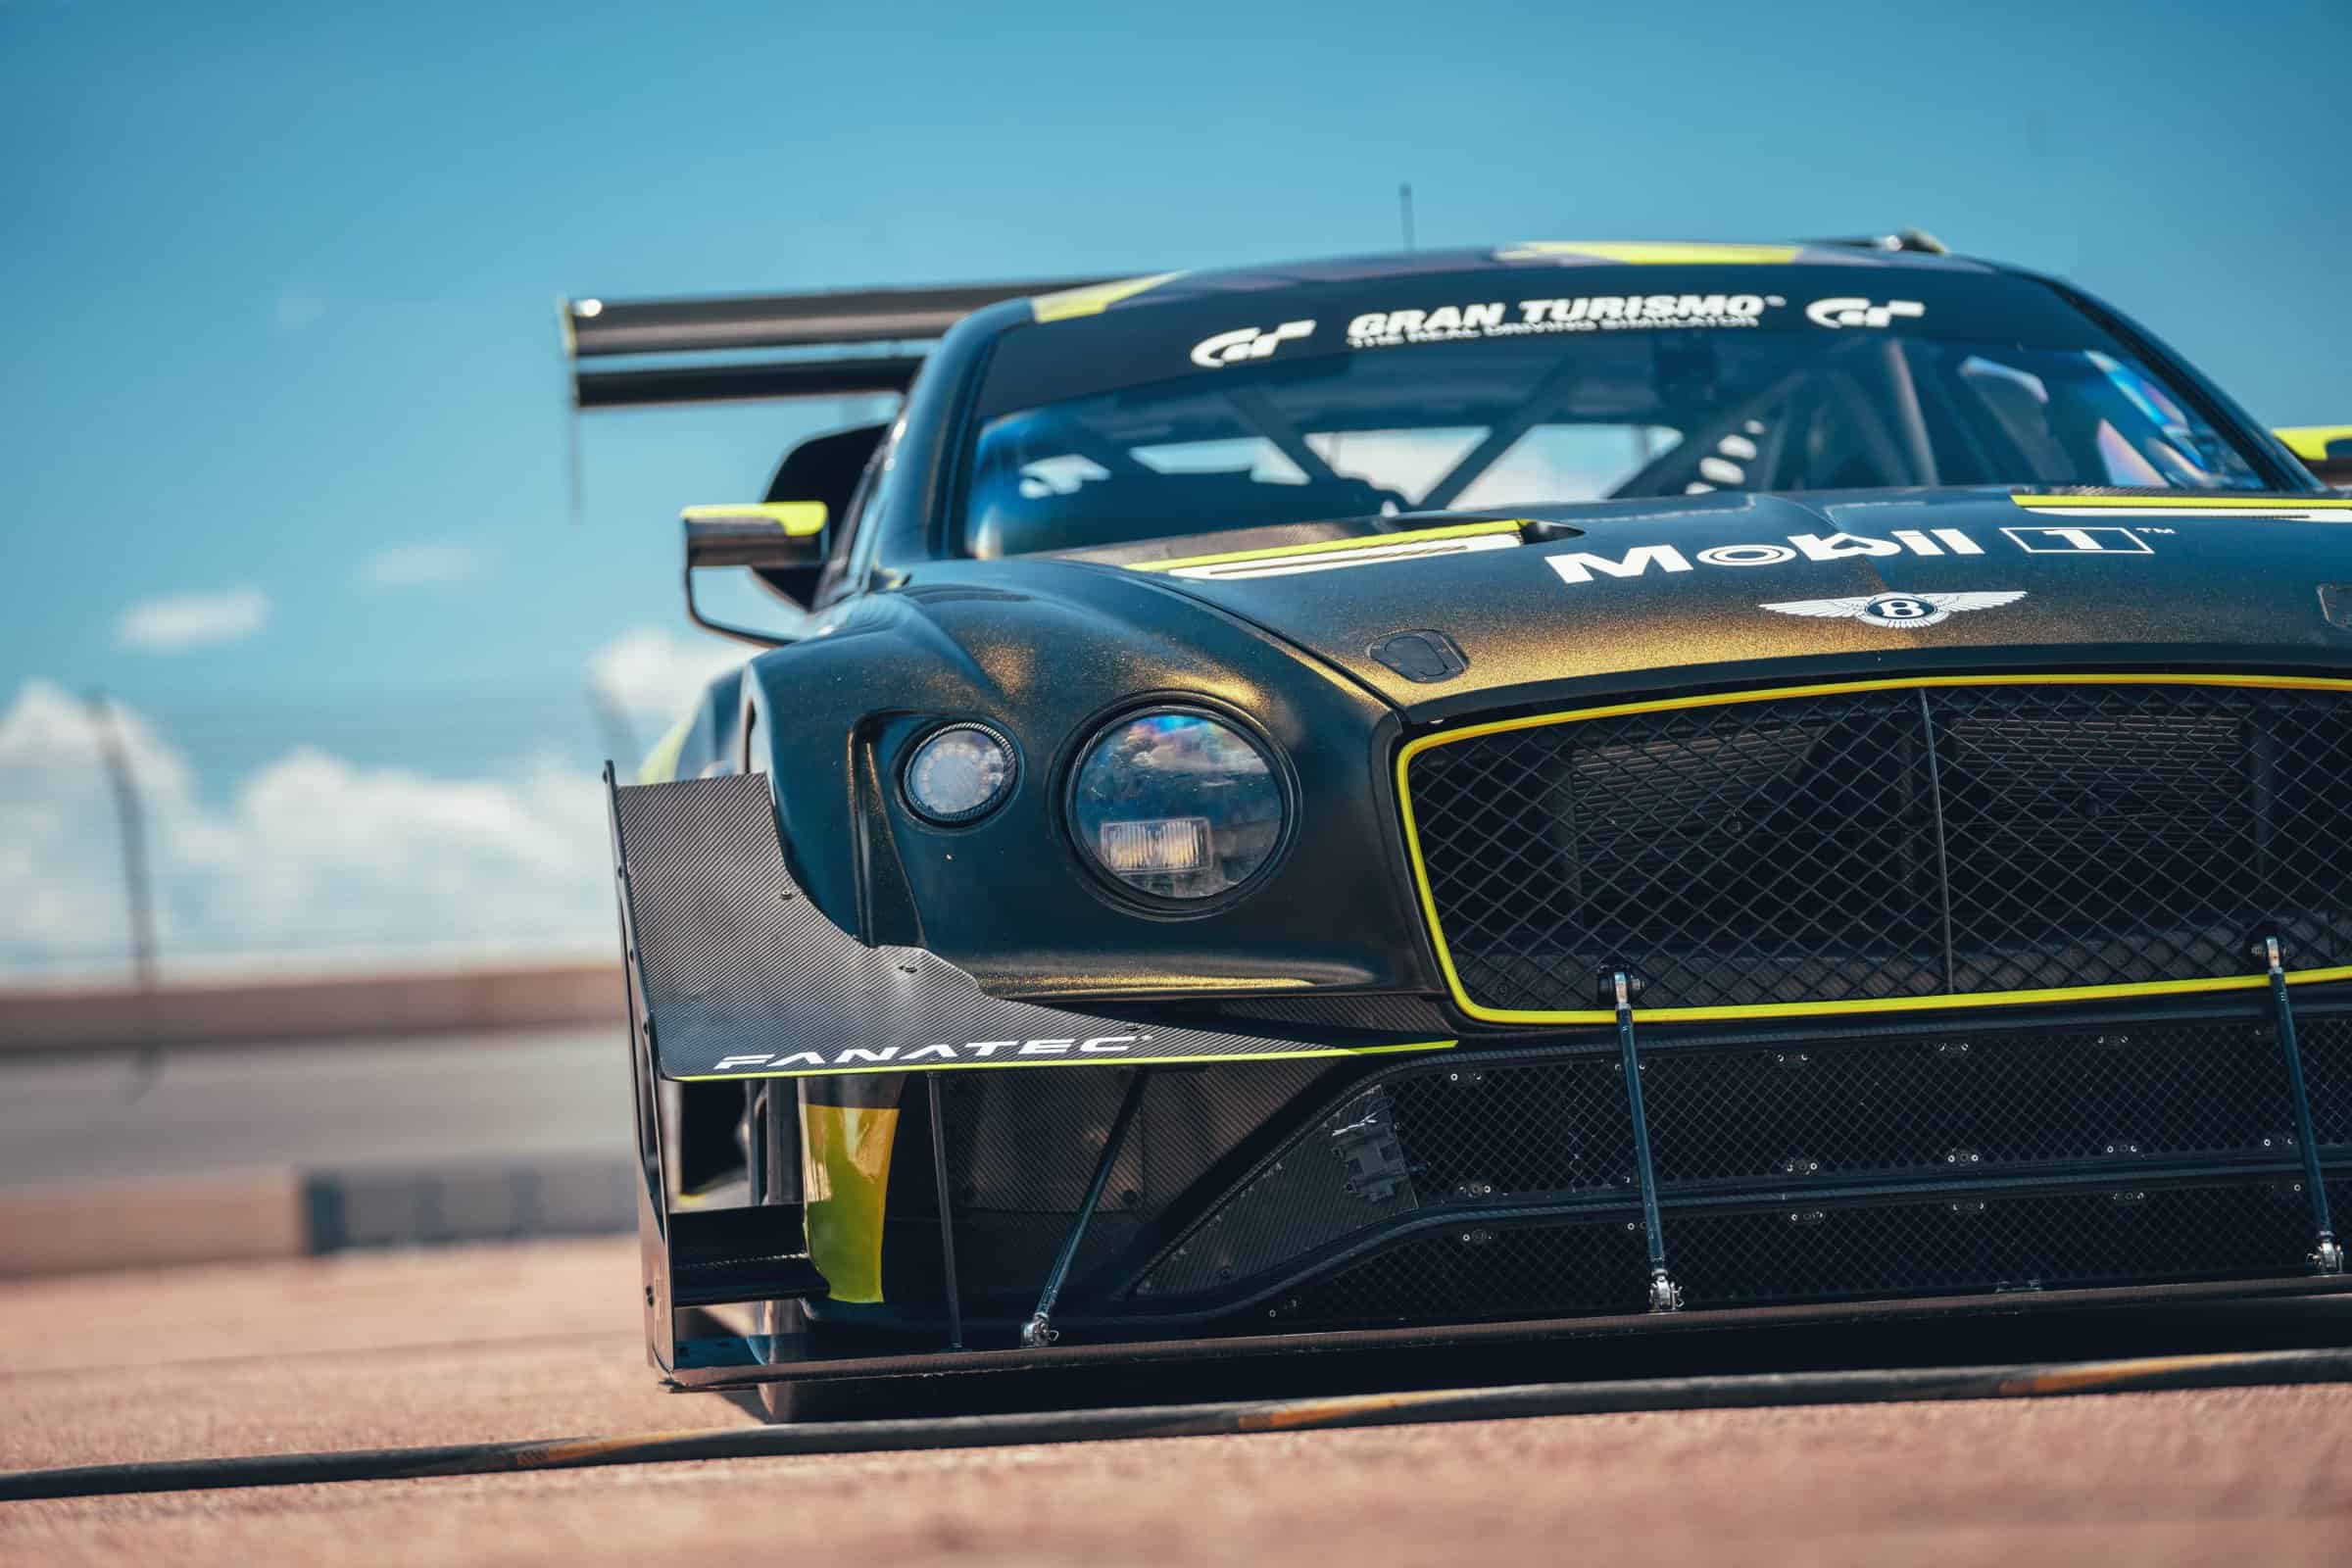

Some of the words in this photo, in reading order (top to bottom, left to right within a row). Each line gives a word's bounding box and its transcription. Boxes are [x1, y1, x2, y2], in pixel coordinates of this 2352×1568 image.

[1348, 303, 1505, 338] GRAN
[1519, 295, 1765, 323] TURISMO
[1544, 528, 1985, 584] Mobil
[713, 1036, 1137, 1070] FANATEC
